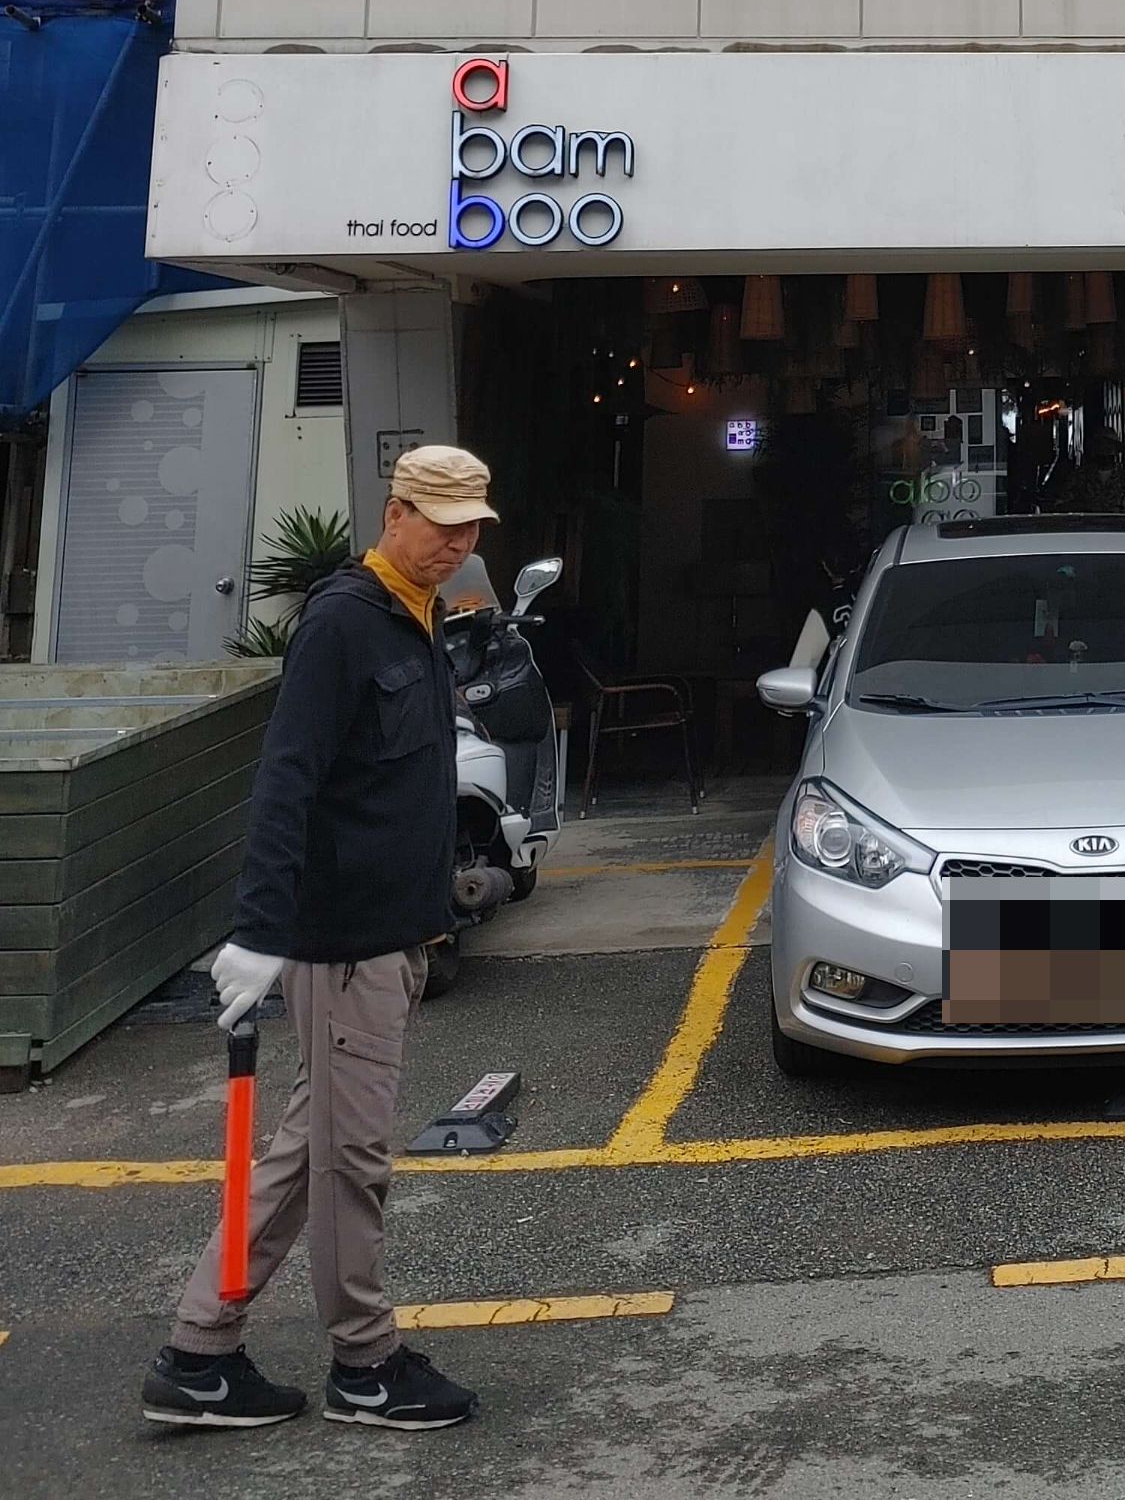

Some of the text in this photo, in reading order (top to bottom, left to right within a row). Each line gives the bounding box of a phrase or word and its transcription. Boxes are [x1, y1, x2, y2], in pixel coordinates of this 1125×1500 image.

[452, 58, 509, 113] a
[451, 110, 635, 180] bam
[346, 219, 438, 238] thai food
[448, 178, 624, 250] boo
[1078, 837, 1112, 851] KIA
